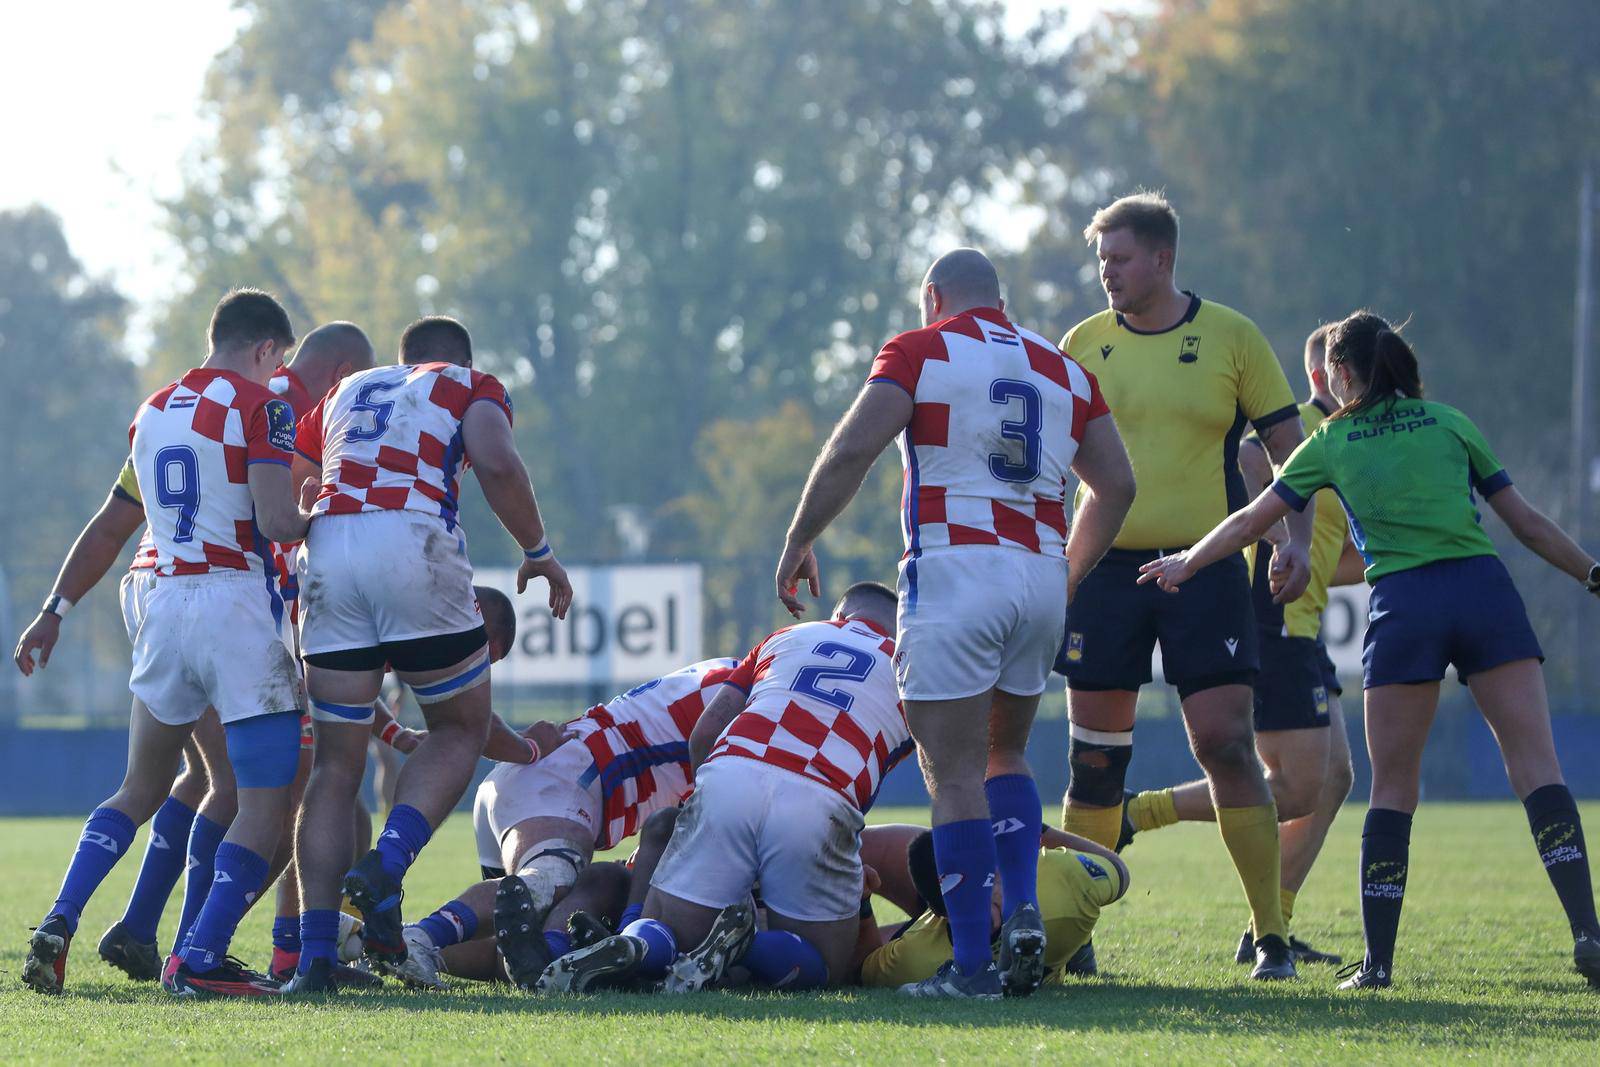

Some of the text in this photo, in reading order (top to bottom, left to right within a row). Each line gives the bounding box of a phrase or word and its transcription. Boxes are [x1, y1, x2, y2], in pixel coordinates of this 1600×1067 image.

[343, 378, 407, 443] 5
[989, 378, 1042, 484] 3
[1347, 417, 1438, 442] europe
[1353, 406, 1426, 427] rugby
[154, 445, 200, 543] 9
[790, 641, 876, 712] 2
[1541, 845, 1578, 861] rugby
[1367, 882, 1403, 893] rugby
